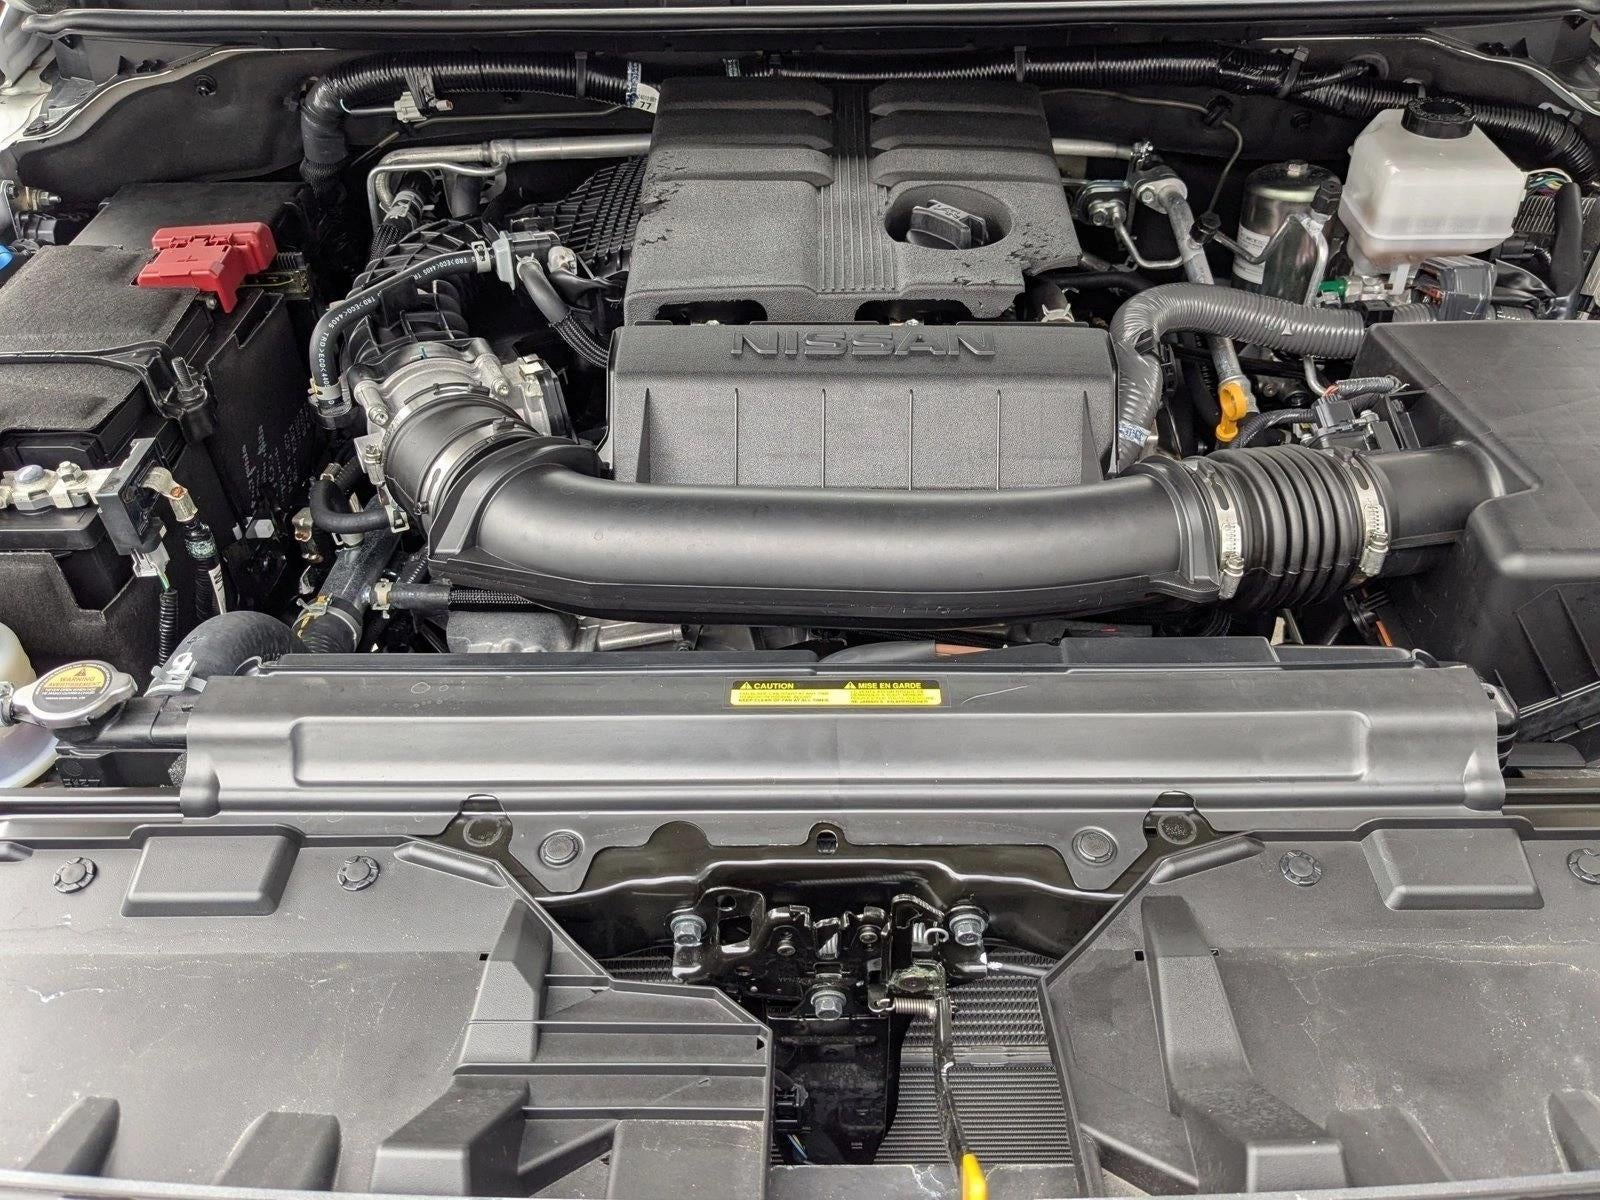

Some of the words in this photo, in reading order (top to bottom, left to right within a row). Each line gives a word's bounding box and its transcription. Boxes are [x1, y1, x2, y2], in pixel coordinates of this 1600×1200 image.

[640, 102, 652, 110] 77
[731, 330, 996, 356] NISSAN
[753, 682, 794, 690] CAUTION
